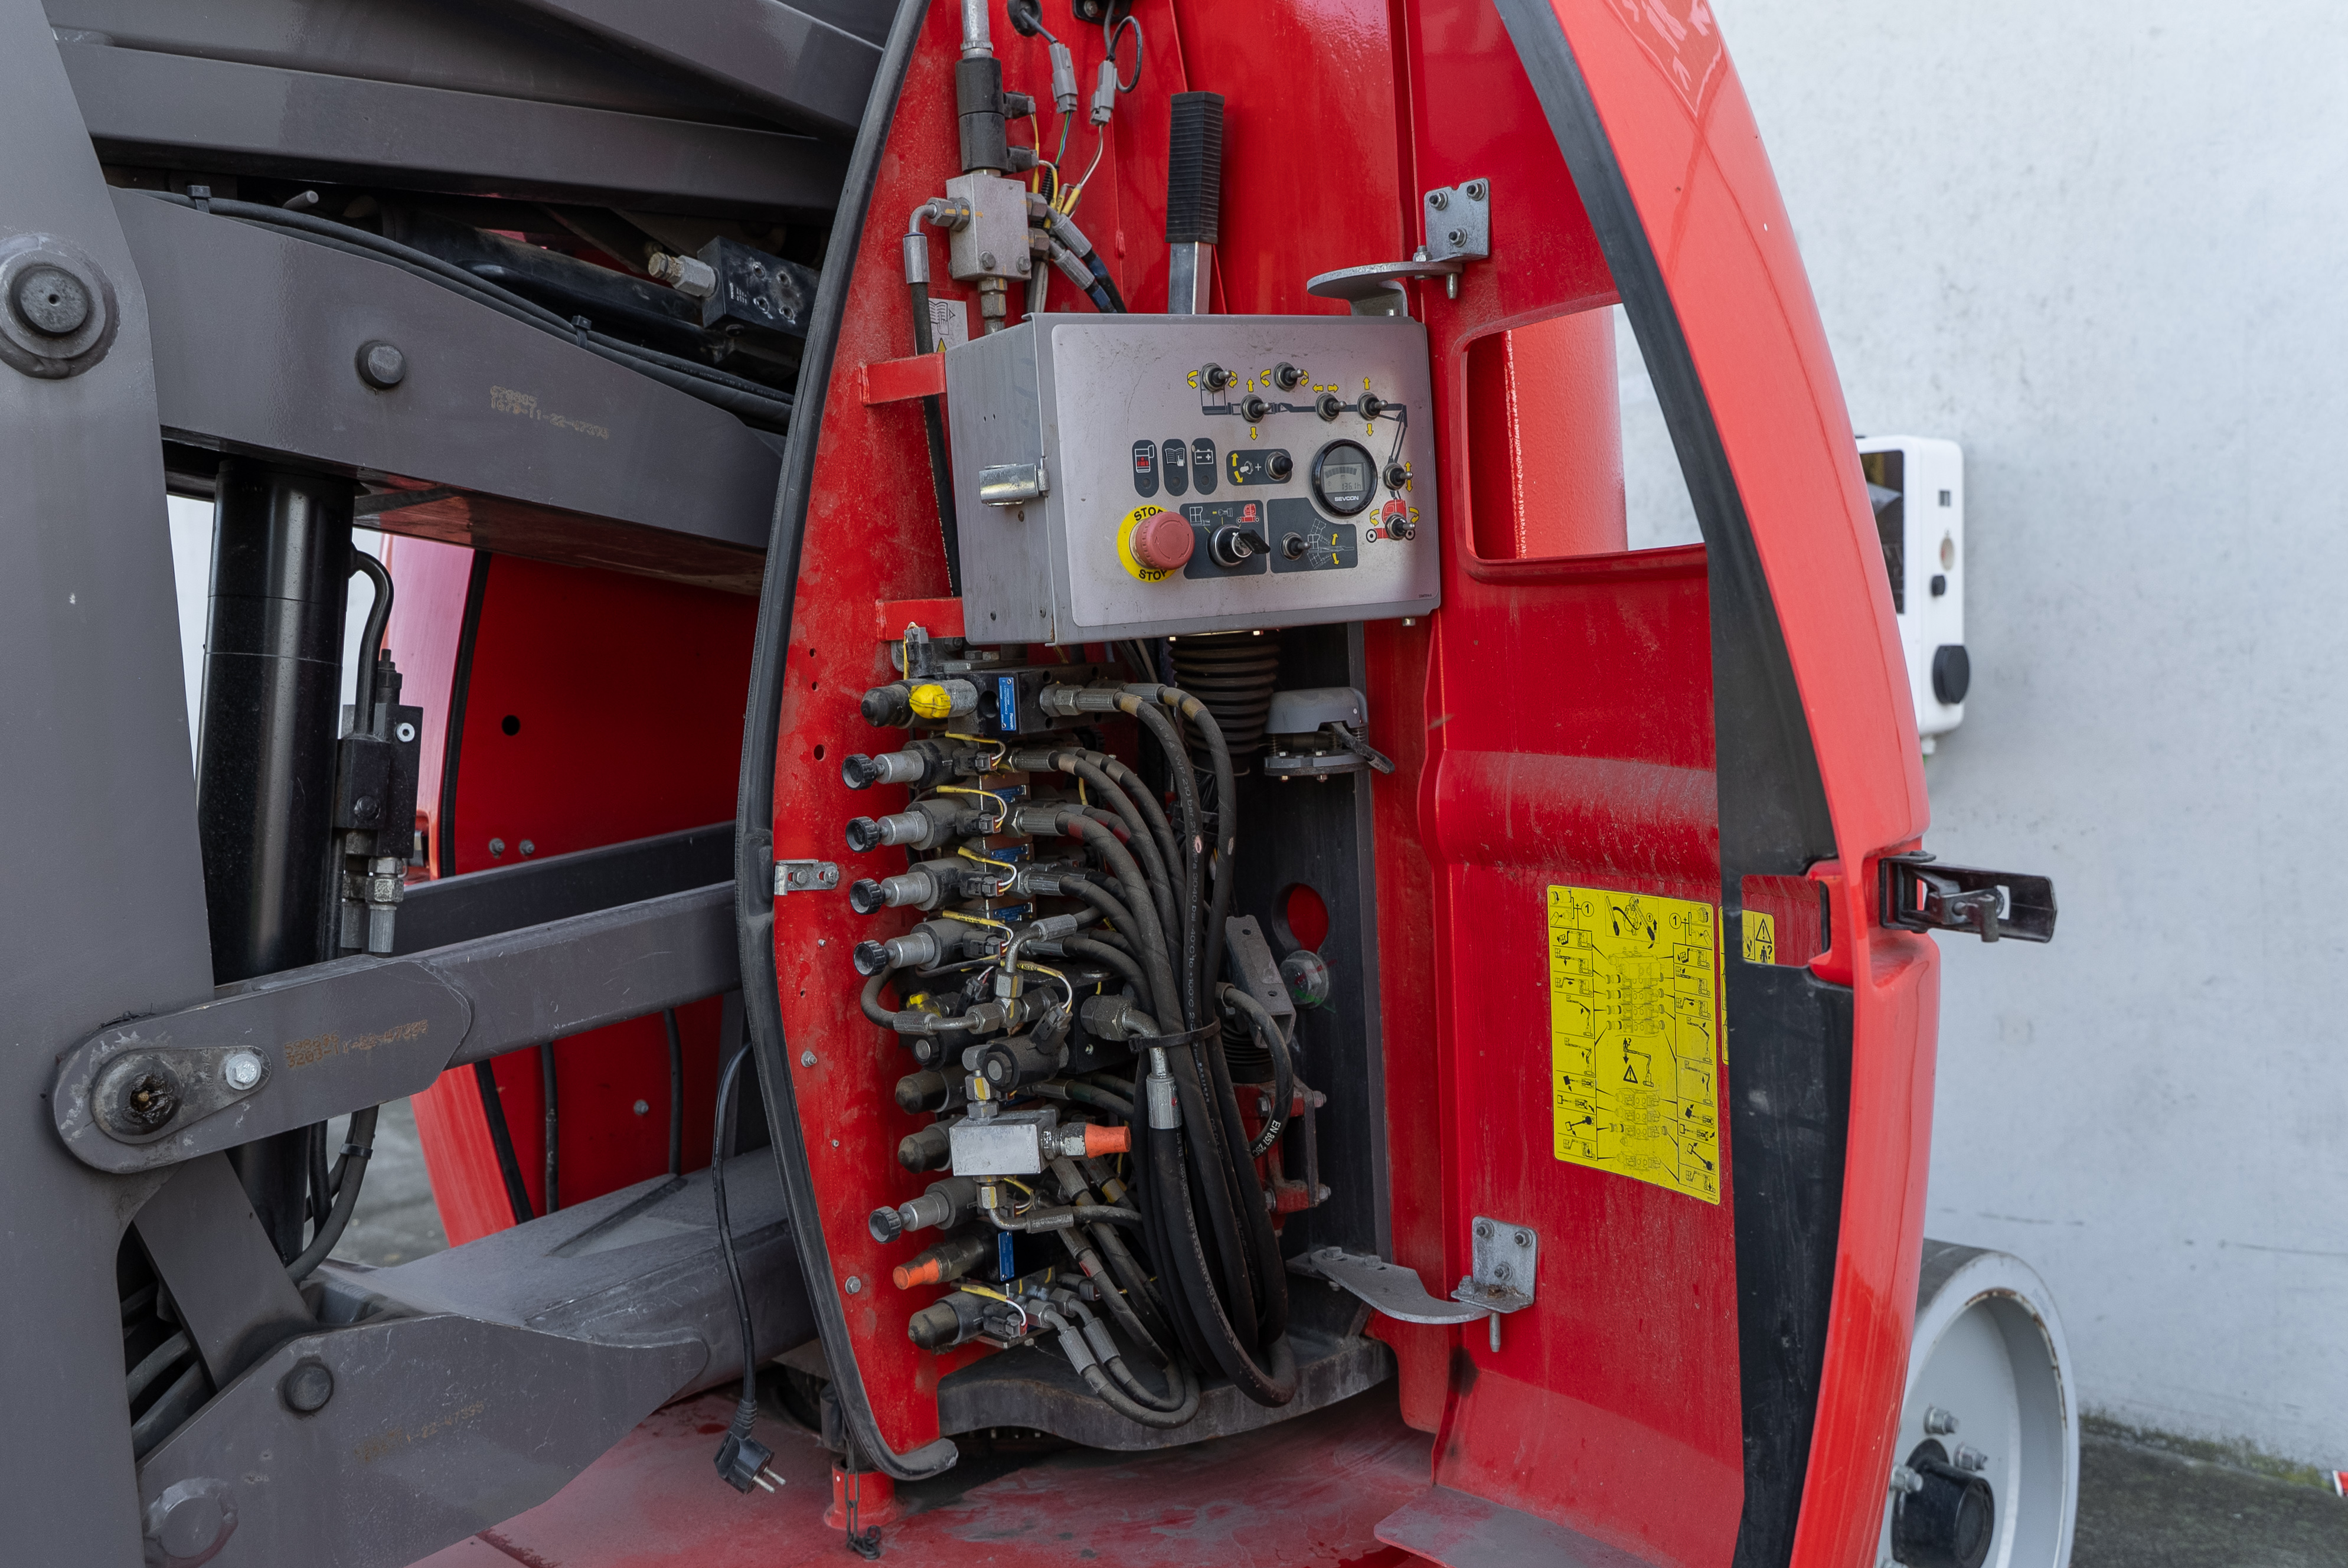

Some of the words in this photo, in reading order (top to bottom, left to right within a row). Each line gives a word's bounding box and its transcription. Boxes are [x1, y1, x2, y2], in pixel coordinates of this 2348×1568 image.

[1182, 778, 1191, 796] 210
[1269, 1120, 1281, 1133] EN
[1263, 1132, 1275, 1146] 857
[1252, 1143, 1266, 1156] 2SC
